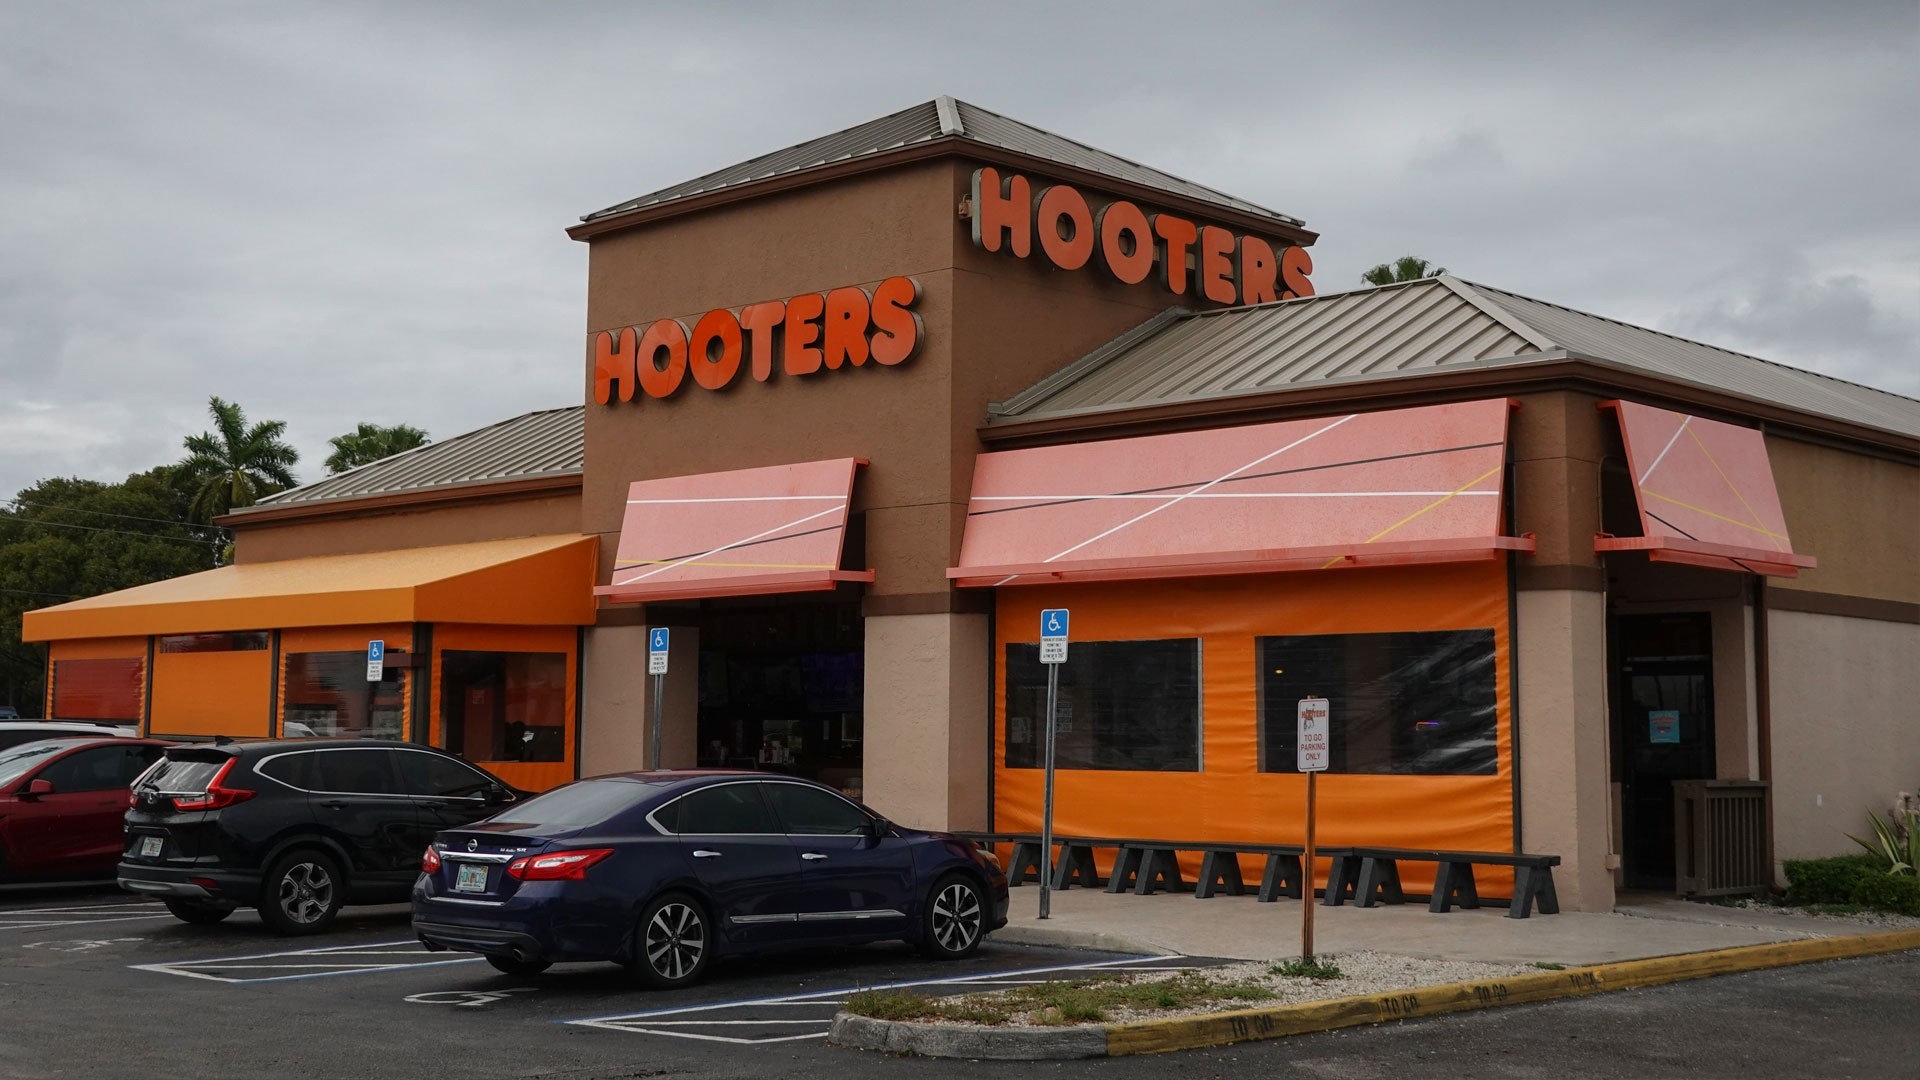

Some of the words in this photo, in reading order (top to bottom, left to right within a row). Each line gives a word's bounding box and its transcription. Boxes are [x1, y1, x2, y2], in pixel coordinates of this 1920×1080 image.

[972, 167, 1315, 306] HOOTERS
[594, 276, 923, 405] HOOTERS
[1313, 733, 1322, 741] GO
[1300, 743, 1326, 751] PARKING
[1305, 752, 1320, 760] ONLY
